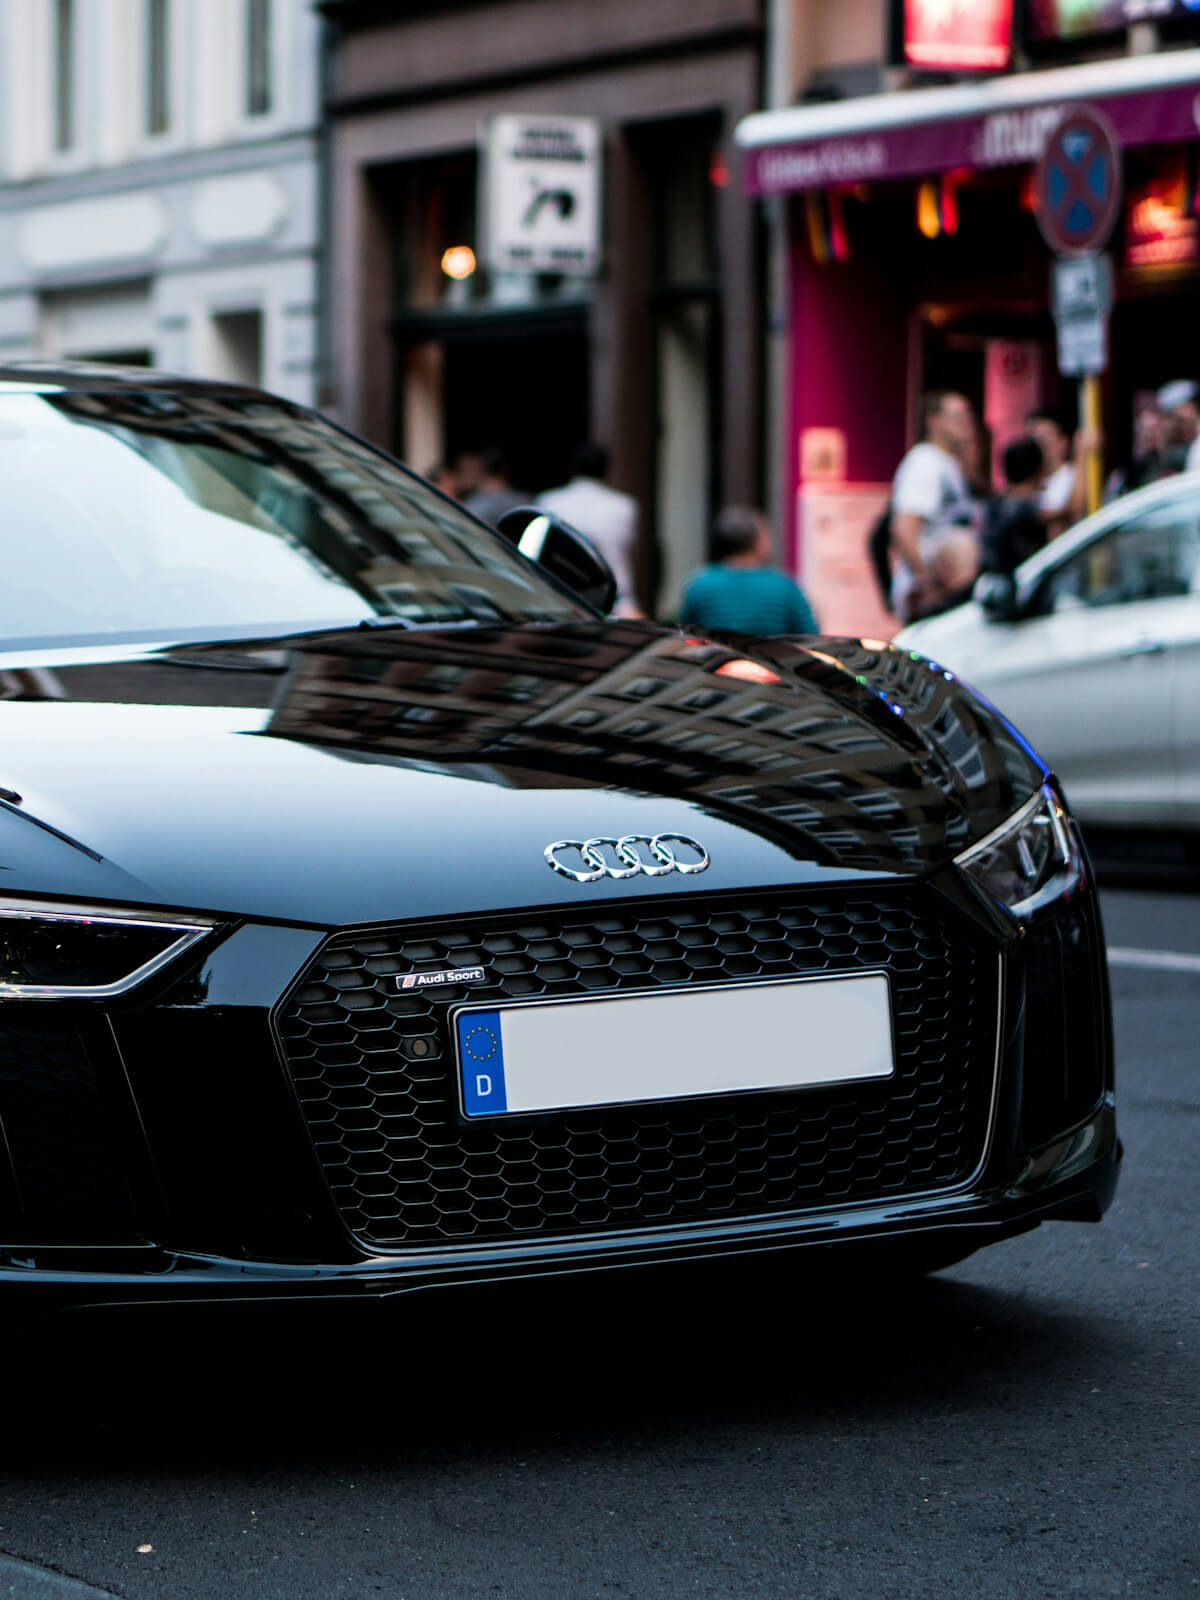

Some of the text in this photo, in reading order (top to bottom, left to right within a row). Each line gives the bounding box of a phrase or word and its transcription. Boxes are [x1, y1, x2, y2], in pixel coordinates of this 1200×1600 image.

[417, 970, 481, 985] Audi Sport
[476, 1074, 492, 1096] D
